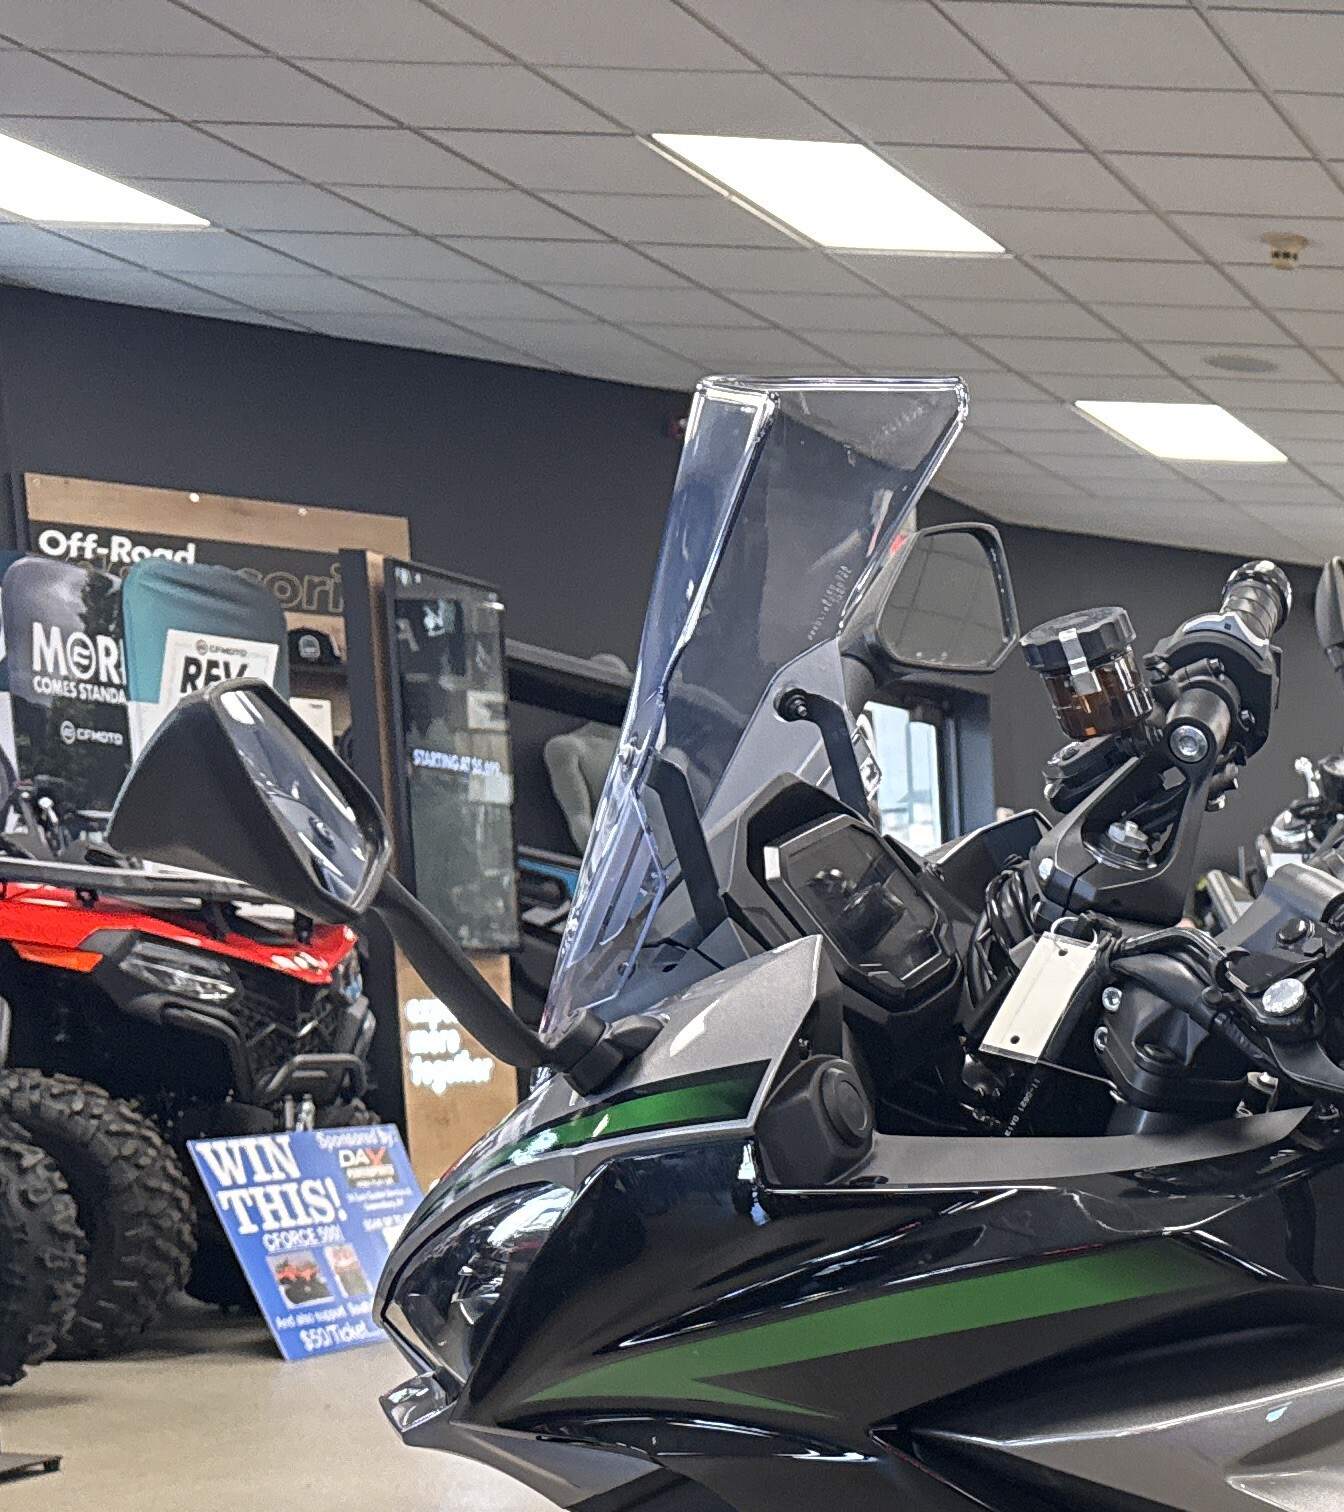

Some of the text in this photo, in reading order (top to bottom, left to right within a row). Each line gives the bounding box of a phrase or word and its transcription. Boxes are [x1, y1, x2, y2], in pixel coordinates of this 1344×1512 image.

[38, 529, 196, 564] Off-Road
[32, 621, 128, 685] MOR
[32, 675, 78, 698] COMES
[76, 727, 123, 746] CFMOTO
[410, 1050, 493, 1095] together
[195, 1136, 300, 1186] WIN
[338, 1147, 386, 1168] DAY
[217, 1177, 348, 1235] THIS!
